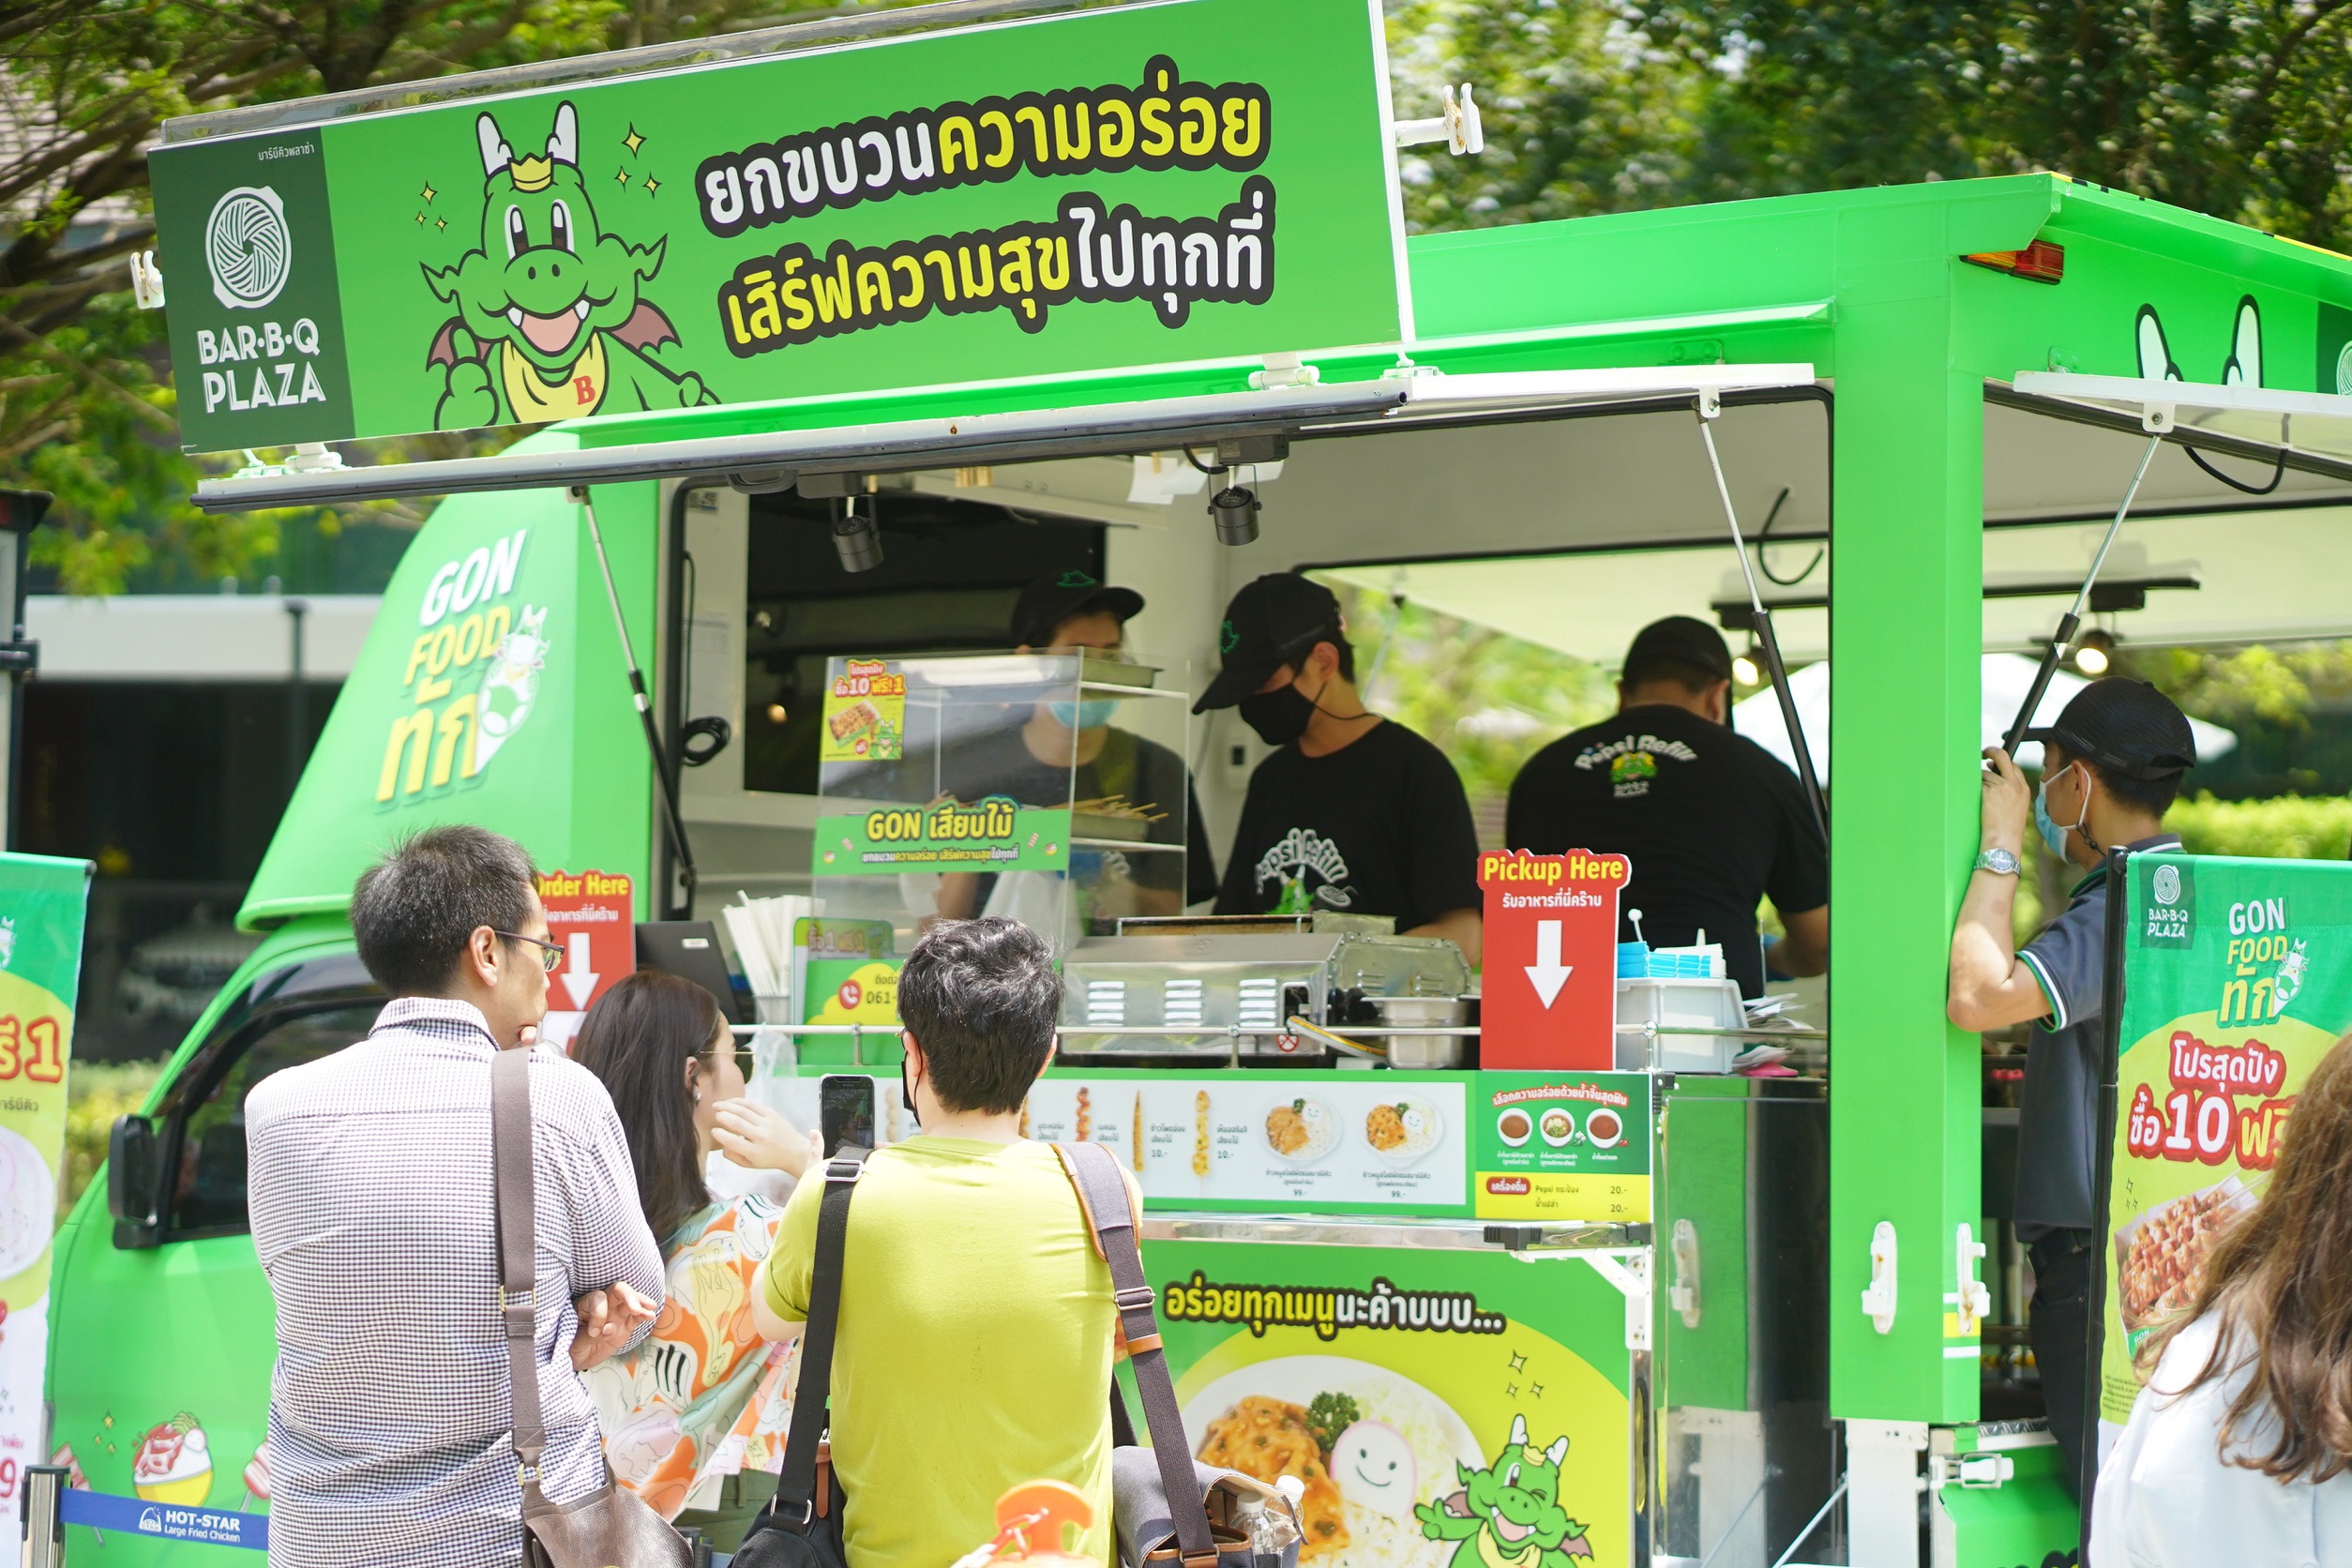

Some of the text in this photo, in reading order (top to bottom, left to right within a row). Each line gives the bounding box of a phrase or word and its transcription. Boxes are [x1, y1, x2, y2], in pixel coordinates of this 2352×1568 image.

[258, 141, 315, 161] บาร์บีคิวพลาซ่า
[703, 68, 1262, 226] ยกขบวนความอร่อย
[727, 189, 1265, 346] เสิร์ฟความสุขไปทุกที่
[203, 361, 326, 414] PLAZA
[572, 374, 596, 406] B
[419, 528, 527, 626] GON
[402, 605, 511, 686] FOOD
[849, 677, 870, 695] 10
[867, 803, 1014, 840] GON เสียบไม้
[585, 873, 629, 897] Here
[1484, 855, 1623, 886] Pickup Here
[2147, 922, 2187, 938] PLAZA
[2227, 897, 2286, 936] GON
[2226, 935, 2289, 966] FOOD
[28, 1020, 62, 1078] 1
[2173, 1039, 2279, 1093] โปรสุดปัง
[2129, 1091, 2161, 1147] ซื้อ
[2164, 1093, 2230, 1154] 10
[1535, 1184, 1554, 1193] Pepsi
[1609, 1185, 1628, 1195] 20.-
[1609, 1203, 1628, 1213] 20.-
[164, 1524, 188, 1538] Large
[188, 1527, 208, 1539] Fried
[209, 1529, 241, 1543] Chicken
[165, 1509, 241, 1532] HOT-STAR
